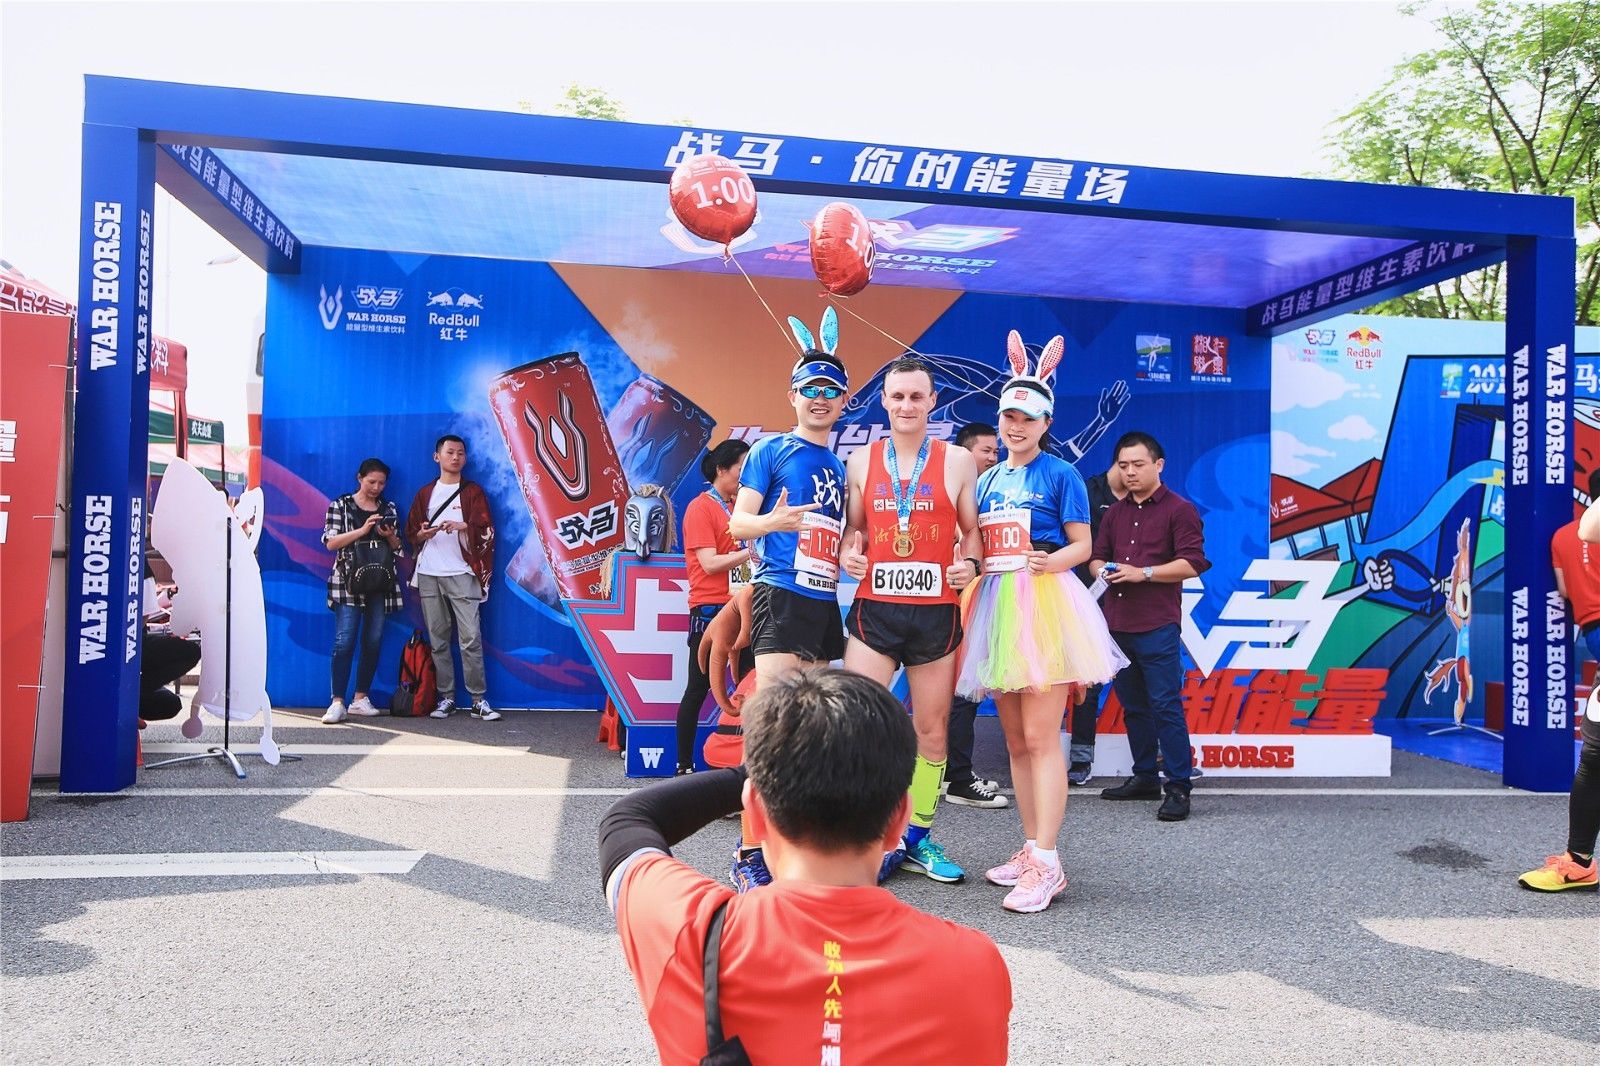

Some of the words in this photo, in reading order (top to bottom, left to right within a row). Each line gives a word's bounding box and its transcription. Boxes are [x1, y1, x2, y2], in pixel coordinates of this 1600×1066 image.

[691, 176, 756, 208] 1:00
[93, 201, 122, 301] HORSE
[138, 210, 151, 309] HORSE
[90, 304, 120, 371] WAR
[137, 315, 149, 374] WAR
[347, 312, 369, 322] WAR
[371, 313, 406, 324] HORSE
[429, 313, 480, 327] RedBull
[440, 327, 468, 341] 红牛
[1347, 347, 1382, 358] RedBull
[1513, 344, 1529, 399] WAR
[1546, 343, 1567, 397] WAR
[1512, 401, 1529, 486] HORSE
[1545, 400, 1566, 485] HORSE
[83, 495, 112, 596] HORSE
[129, 497, 142, 596] HORSE
[875, 568, 933, 591] B10340
[79, 601, 109, 664] WAR
[126, 600, 138, 663] WAR
[1512, 586, 1529, 640] WAR
[1546, 590, 1566, 641] WAR
[1512, 643, 1530, 727] HORSE
[1546, 645, 1567, 729] HORSE
[1200, 745, 1294, 768] HORSE
